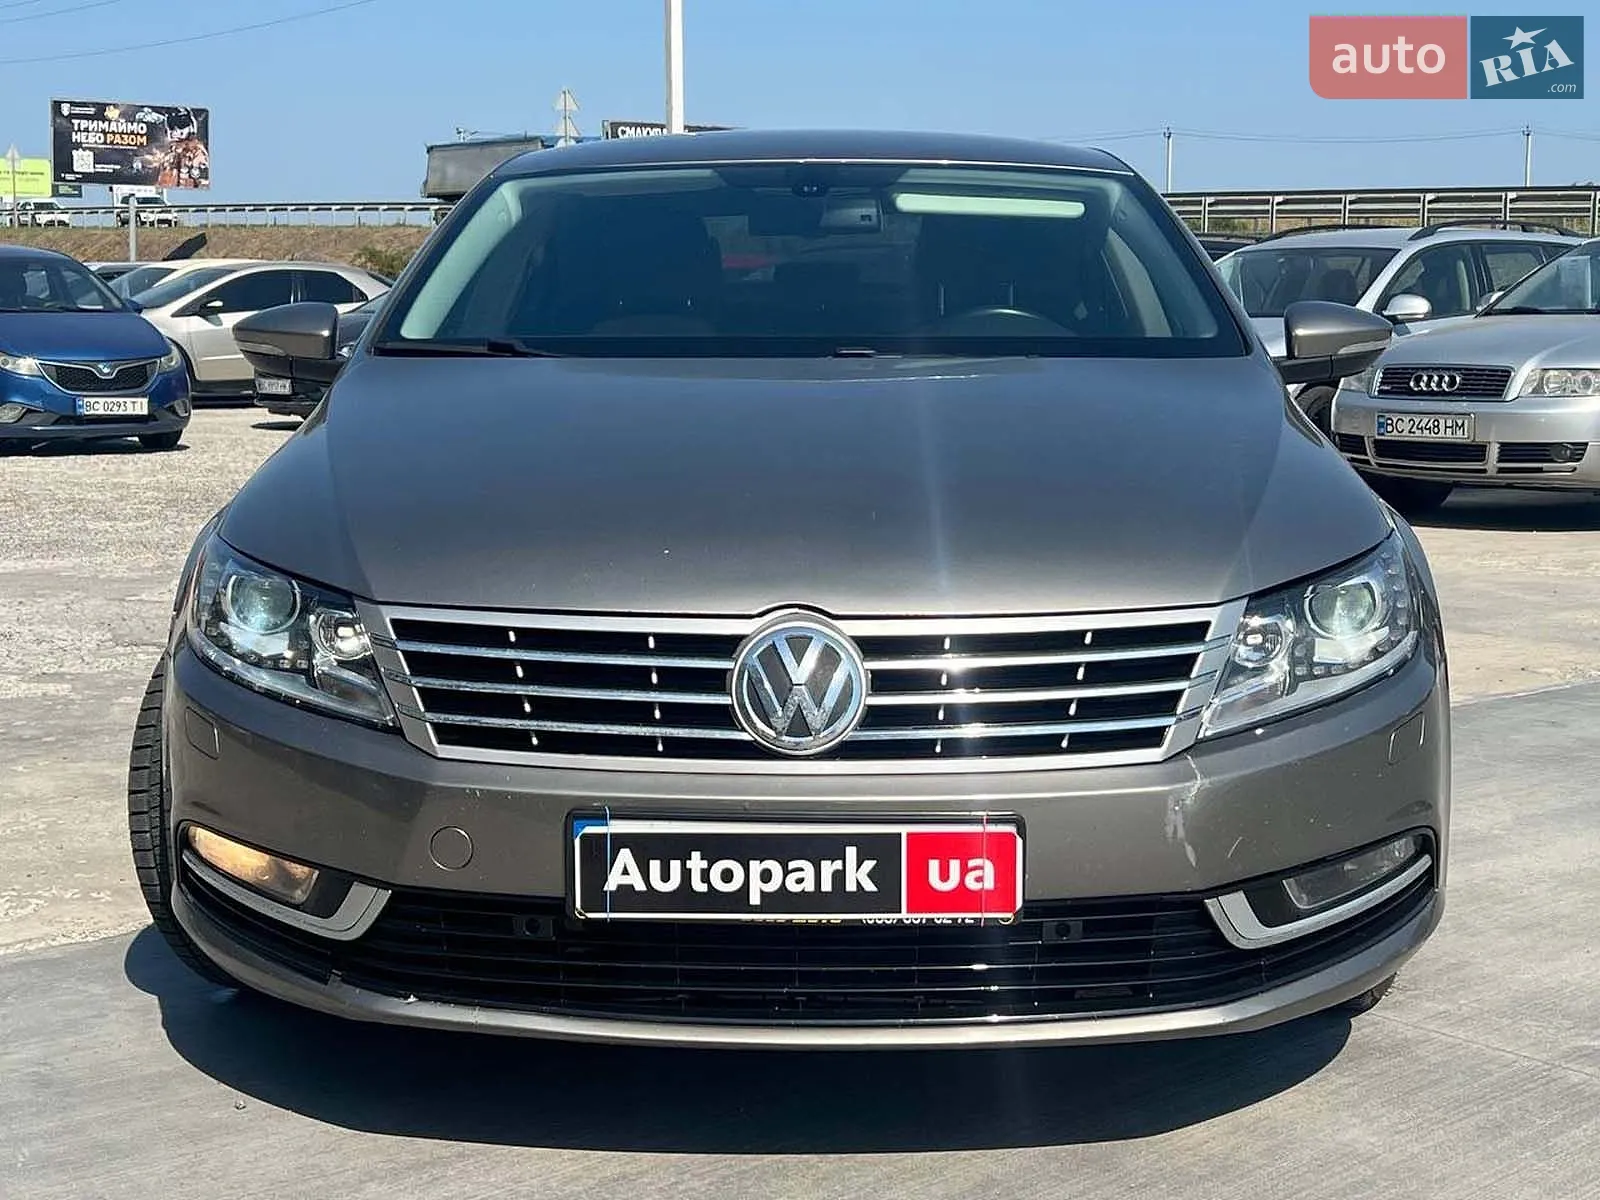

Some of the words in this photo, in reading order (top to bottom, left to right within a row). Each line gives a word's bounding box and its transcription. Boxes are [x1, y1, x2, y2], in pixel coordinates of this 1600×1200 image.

[71, 118, 148, 135] ТРИМАЙМО
[71, 131, 105, 144] НЕБО
[106, 133, 148, 146] РАЗОМ
[85, 400, 101, 413] BC
[103, 400, 128, 413] 0293
[1385, 417, 1405, 434] BC
[1407, 417, 1441, 435] 2448
[1443, 418, 1466, 436] HM
[602, 845, 880, 905] Autopark
[927, 855, 996, 892] ua
